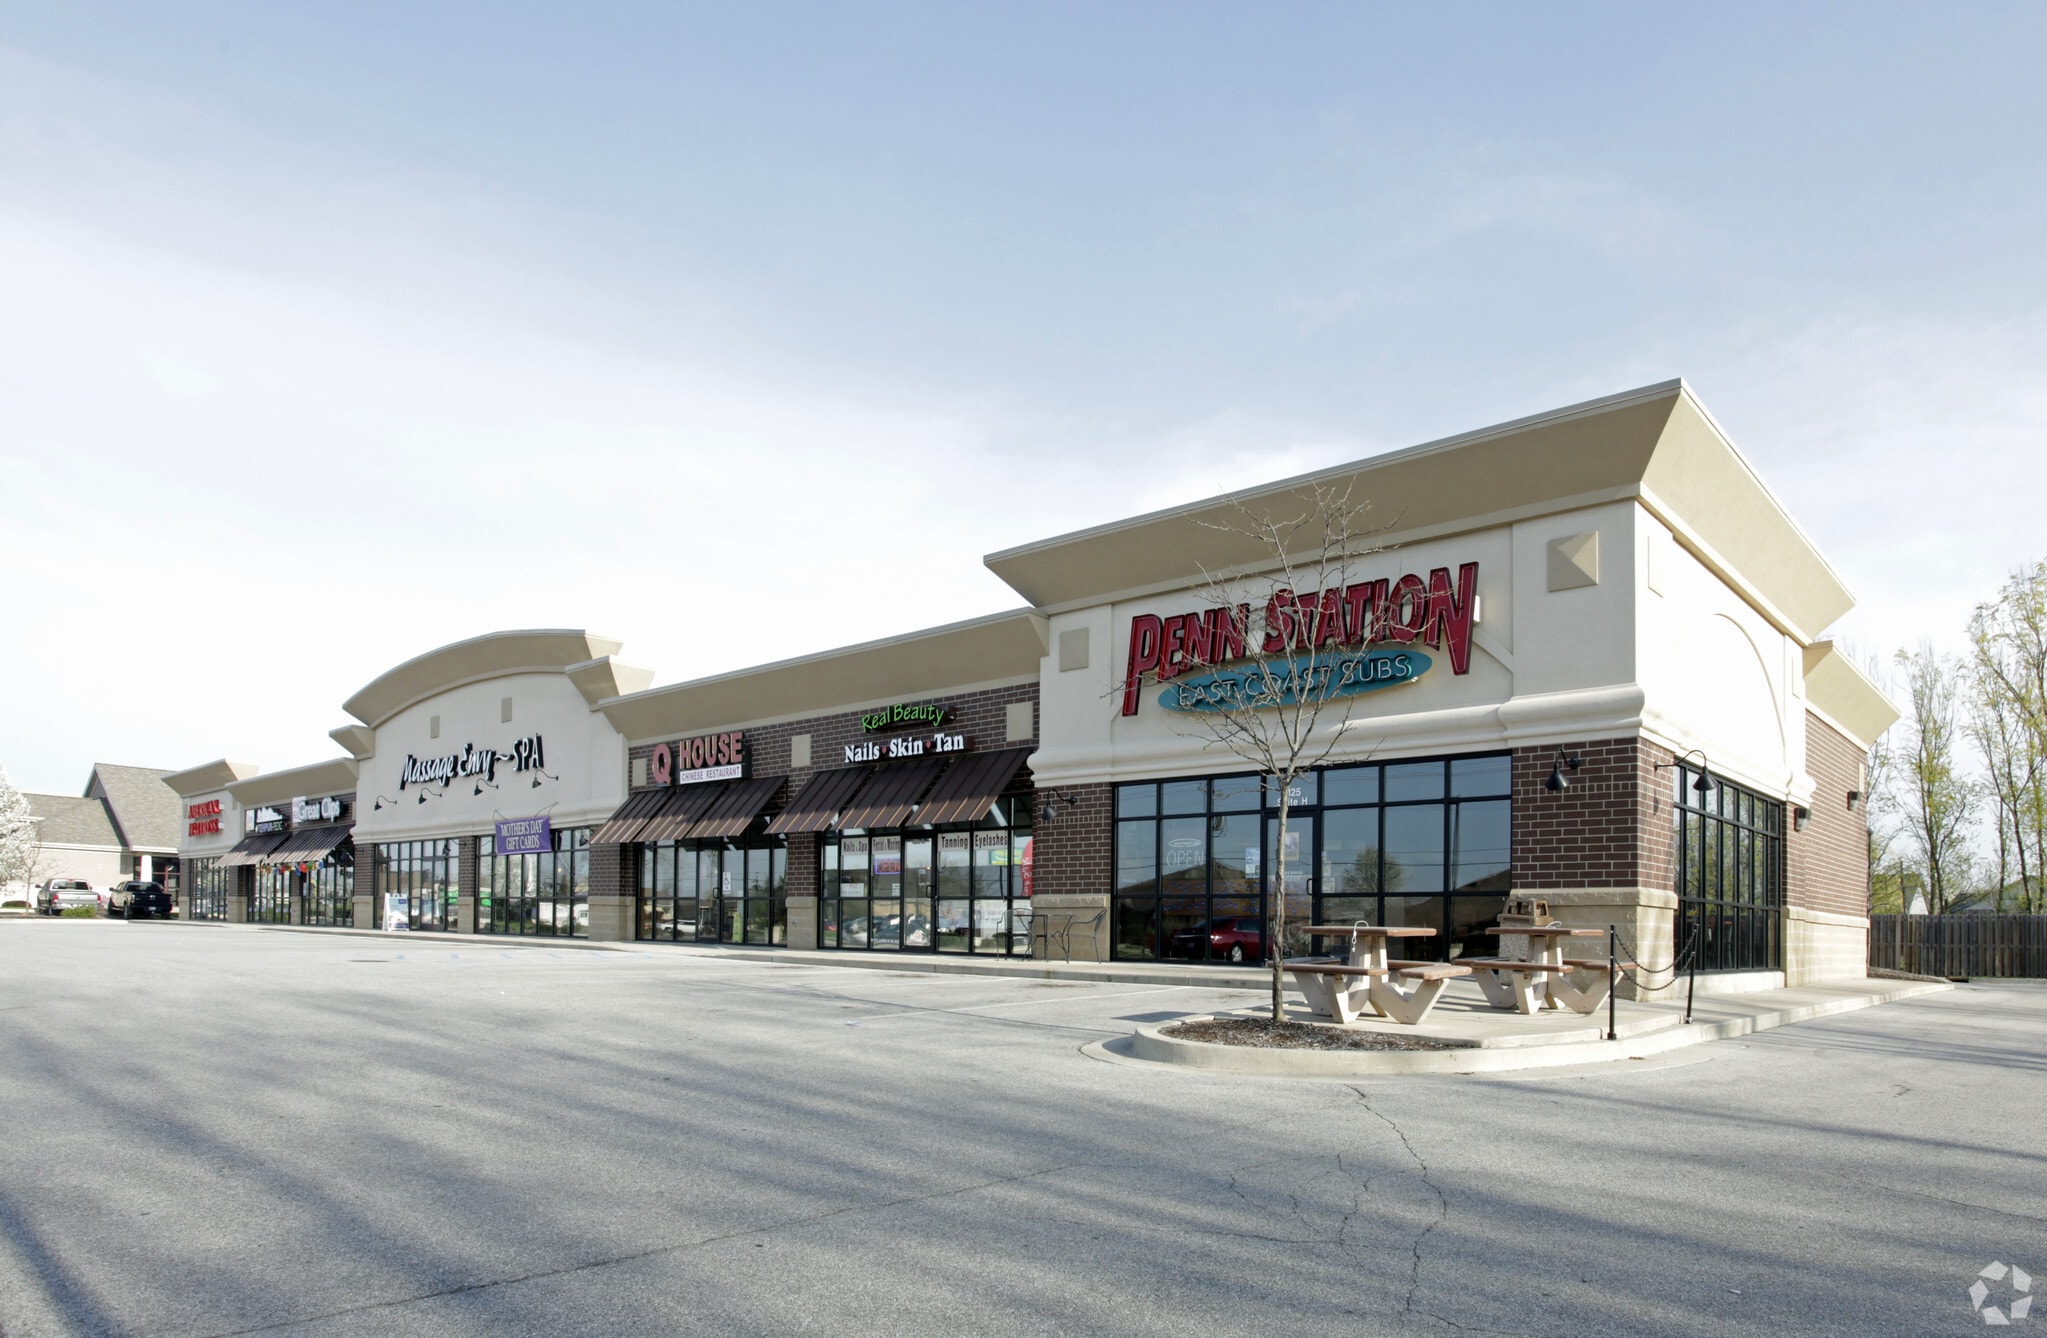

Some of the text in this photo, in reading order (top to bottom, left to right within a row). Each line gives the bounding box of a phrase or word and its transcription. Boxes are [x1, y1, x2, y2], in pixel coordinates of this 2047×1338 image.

[1122, 561, 1479, 716] PENN STATION
[1178, 655, 1413, 706] EAST COAST SUBS
[861, 703, 944, 732] Real Beauty
[652, 731, 743, 785] Q HOUSE
[844, 733, 964, 763] Nails Skin Tan
[400, 733, 544, 789] Massage Envy SPA
[681, 766, 740, 782] CHINESE RESTAURANT
[298, 800, 321, 820] Great
[321, 796, 341, 822] Clips
[1277, 796, 1308, 807] Site H
[530, 819, 543, 834] DAY
[505, 834, 540, 850] GIFT CARDS
[859, 840, 868, 853] Spa
[941, 836, 968, 849] Tanning
[974, 833, 1008, 848] Eyelashes
[1166, 850, 1204, 867] OPEN
